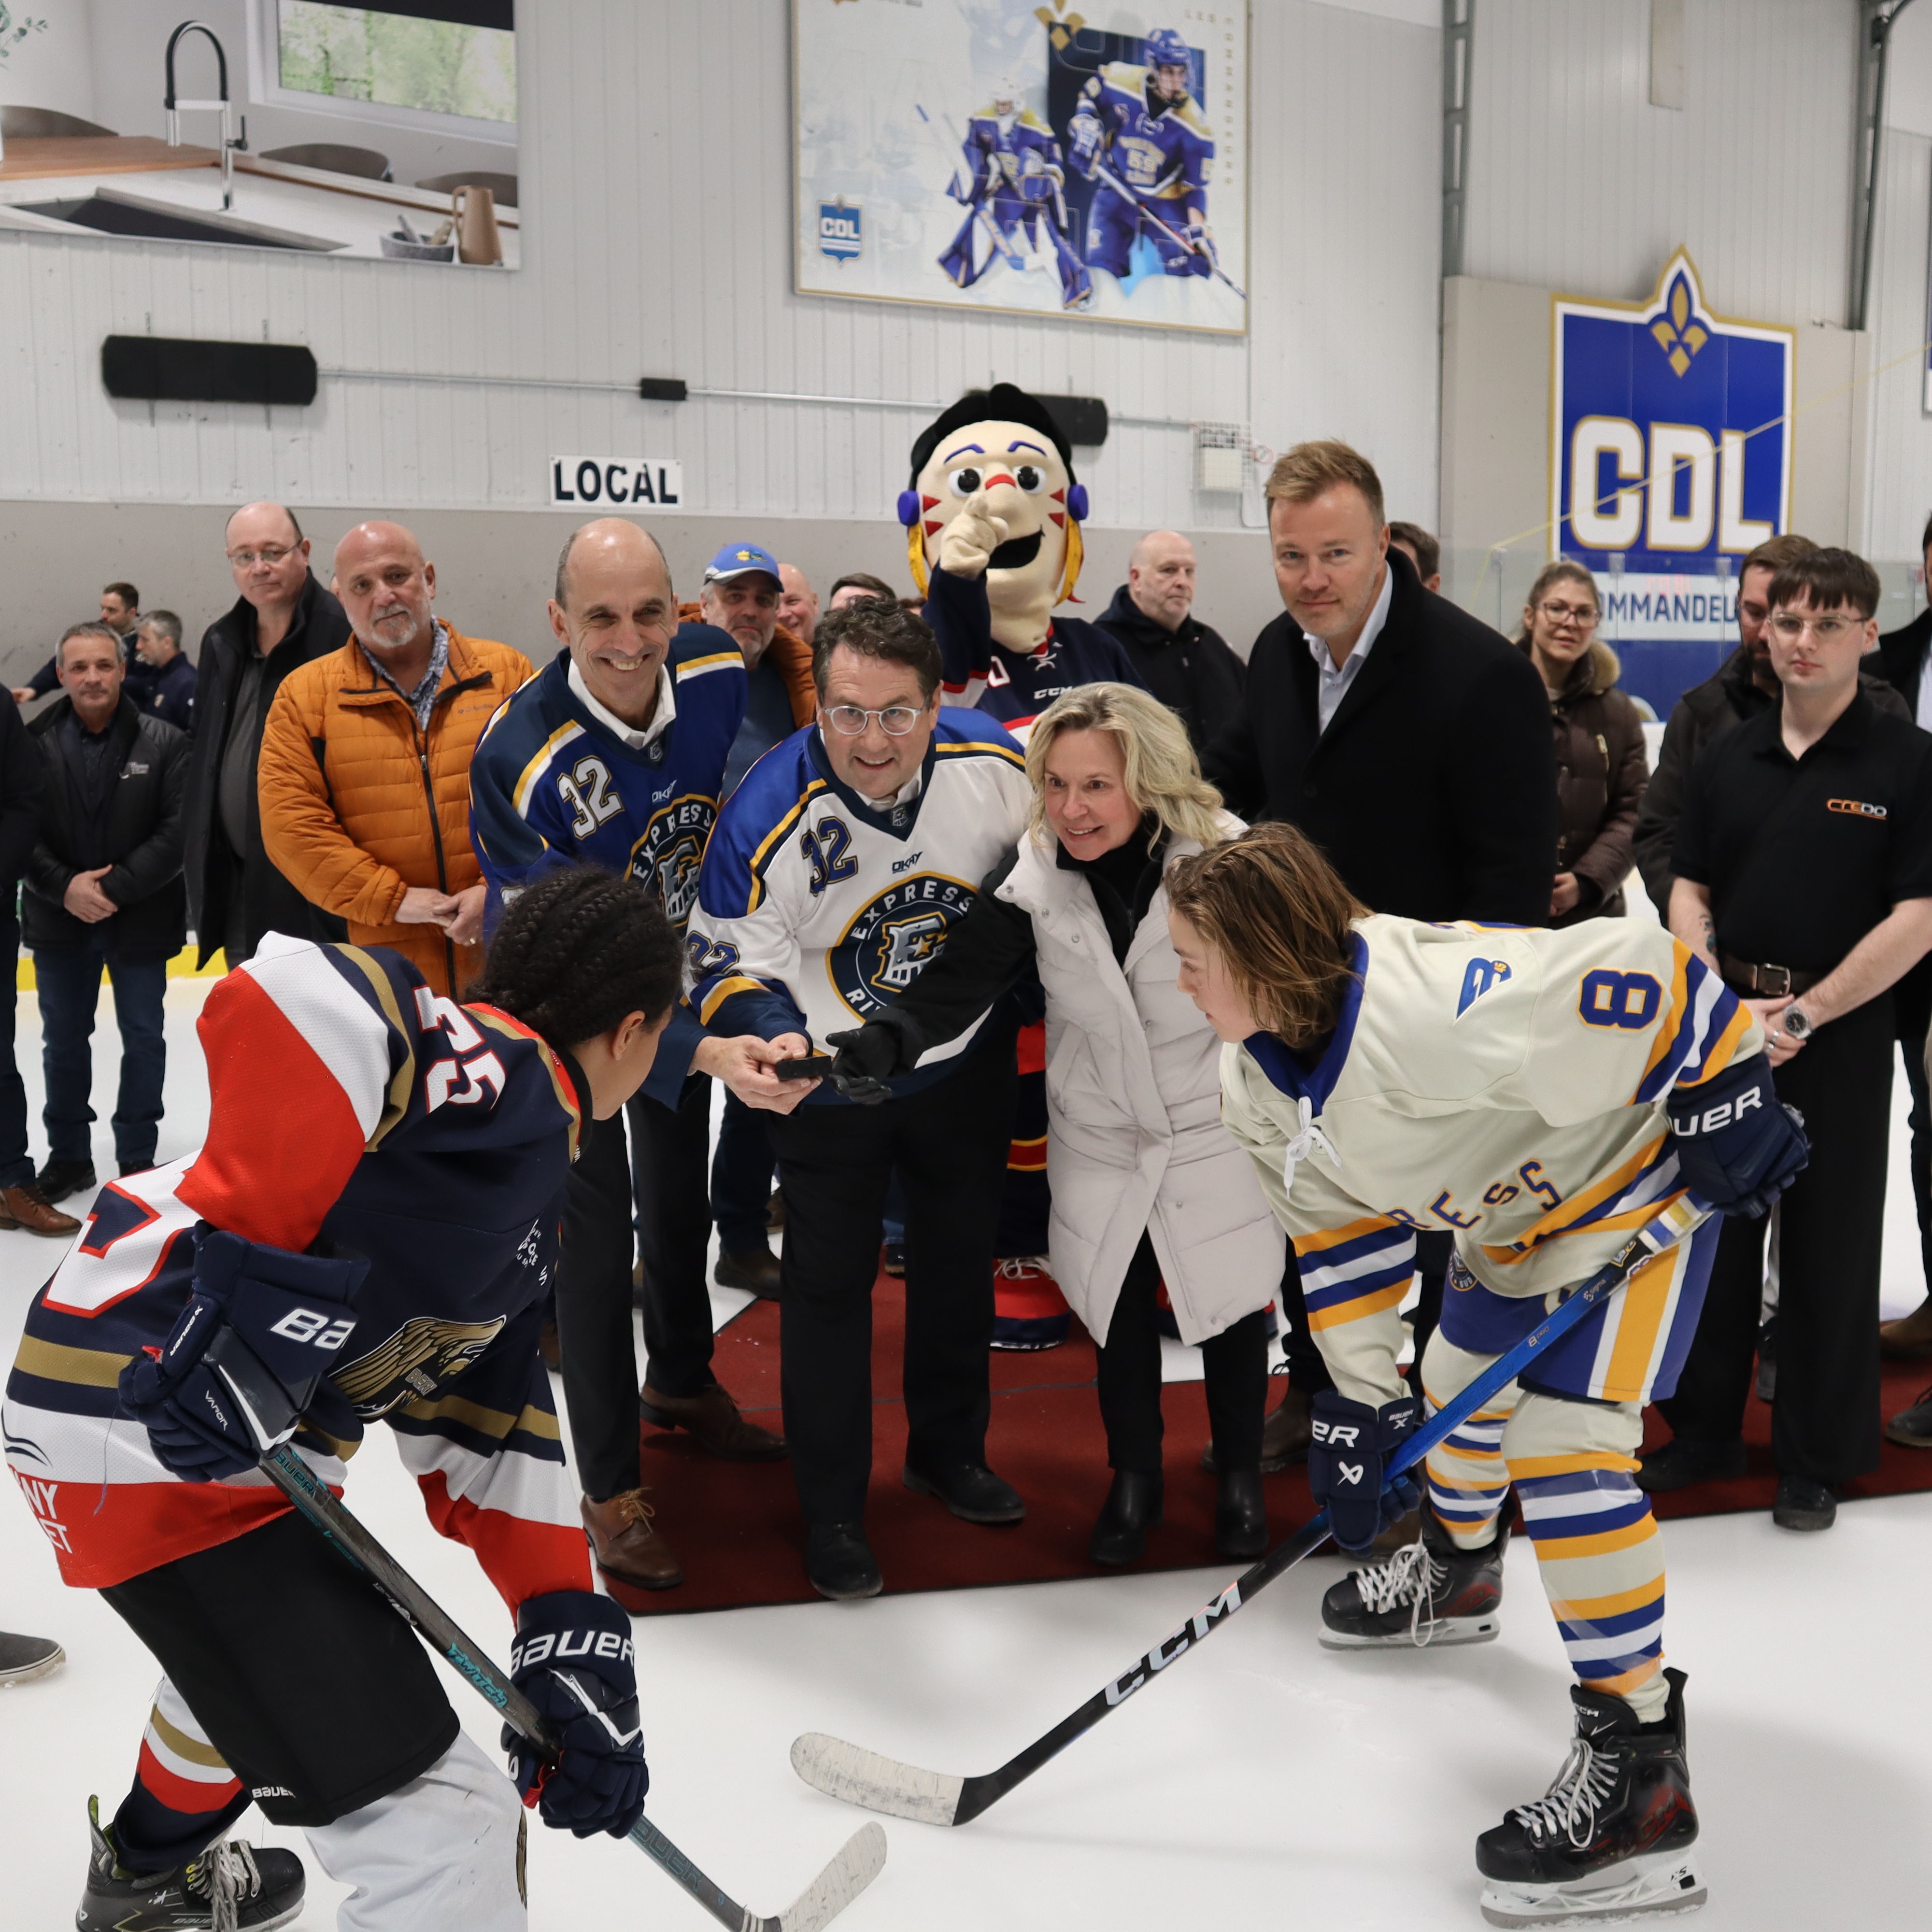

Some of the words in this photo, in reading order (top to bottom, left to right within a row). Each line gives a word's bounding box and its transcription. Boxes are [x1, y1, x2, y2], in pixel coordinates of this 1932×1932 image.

[821, 217, 859, 240] CDL
[554, 459, 678, 503] LOCAL
[1570, 414, 1773, 553] CDL
[557, 755, 625, 840] 32
[800, 816, 859, 897] 32
[850, 880, 974, 940] EXPRESS
[845, 988, 881, 1013] RI
[1576, 966, 1665, 1032] 8
[1529, 1335, 1537, 1348] 8
[1388, 1409, 1414, 1421] BAUER
[1105, 1580, 1242, 1706] CCM
